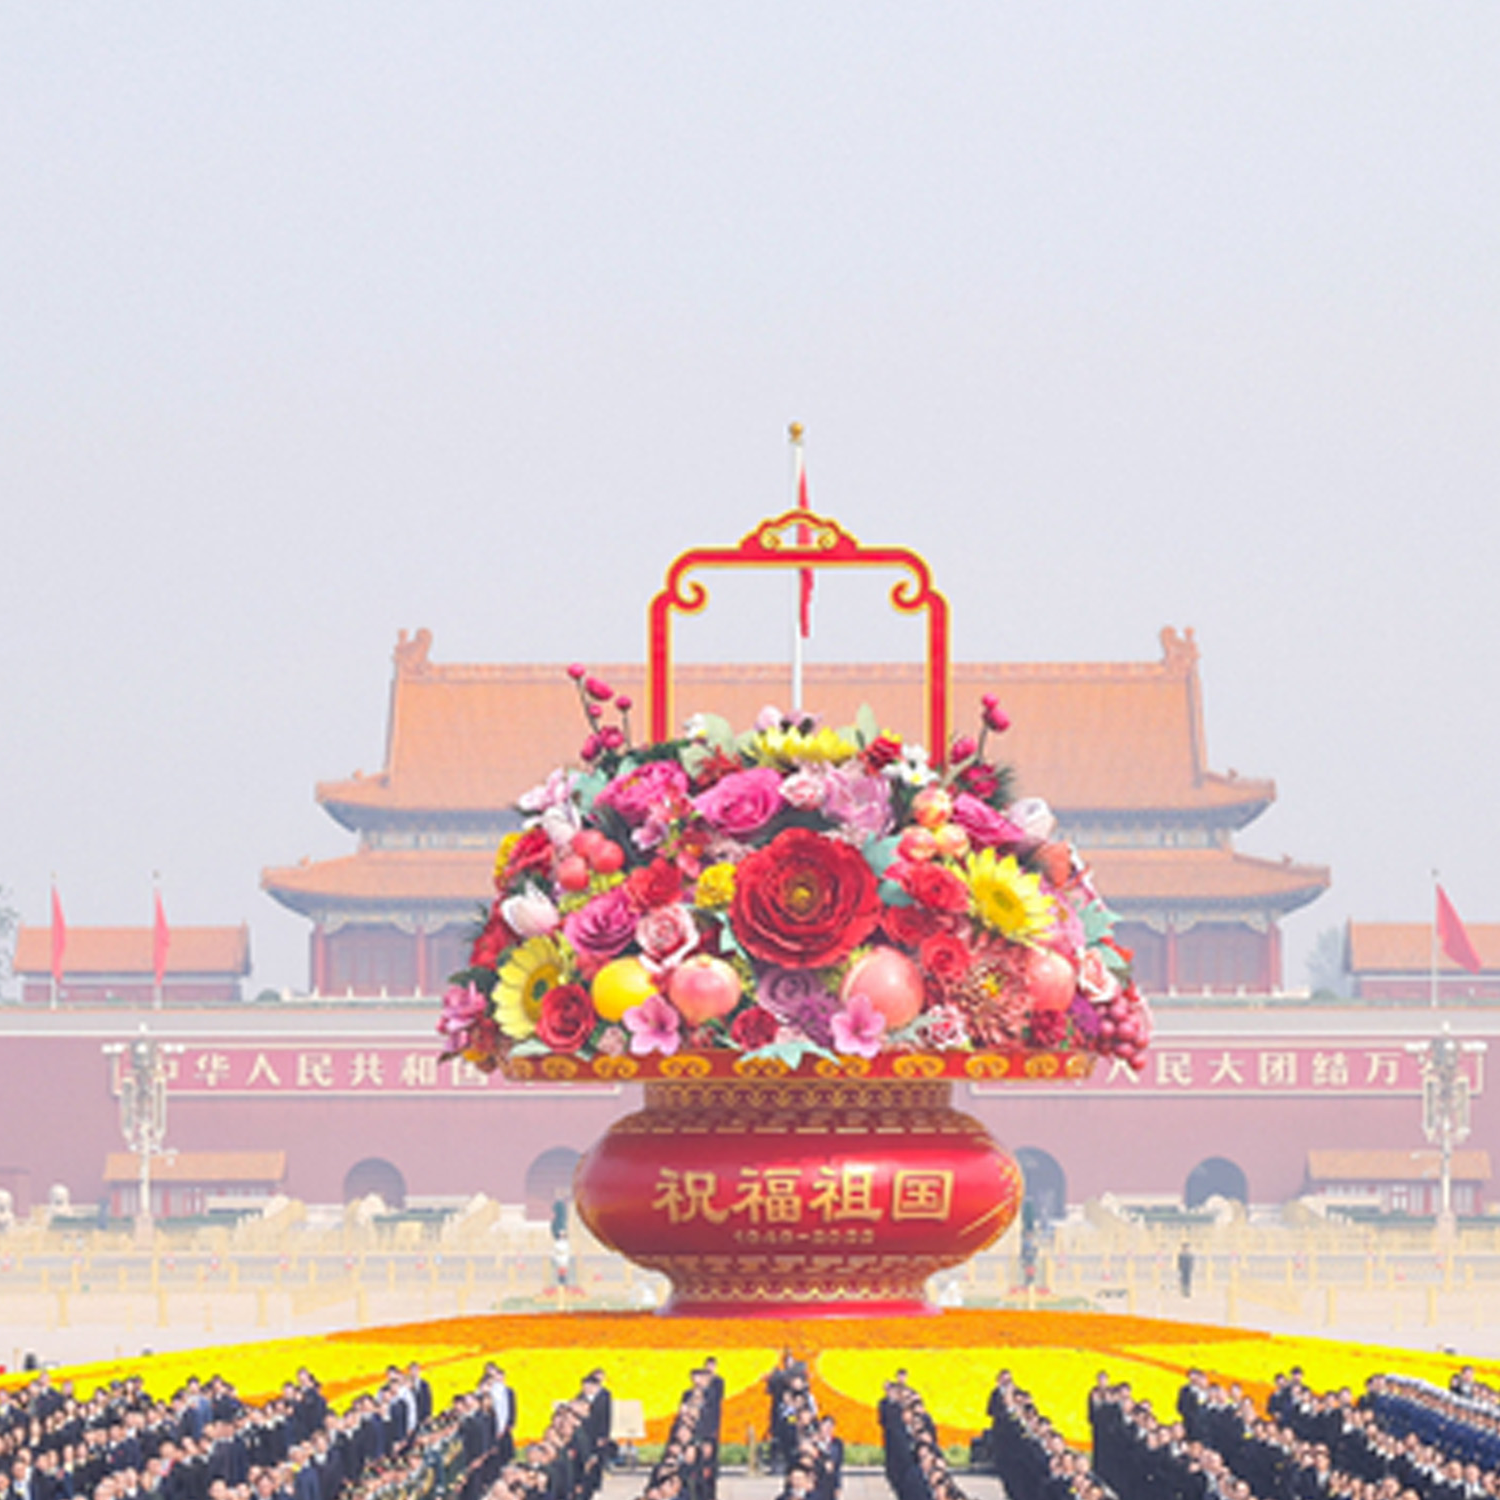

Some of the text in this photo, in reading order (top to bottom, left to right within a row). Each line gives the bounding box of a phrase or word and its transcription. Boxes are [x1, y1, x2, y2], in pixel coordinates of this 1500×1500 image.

[154, 1052, 572, 1087] 中华人民共和国
[1003, 1050, 1434, 1087] 人民大团结万
[651, 1166, 955, 1224] 祝福祖国
